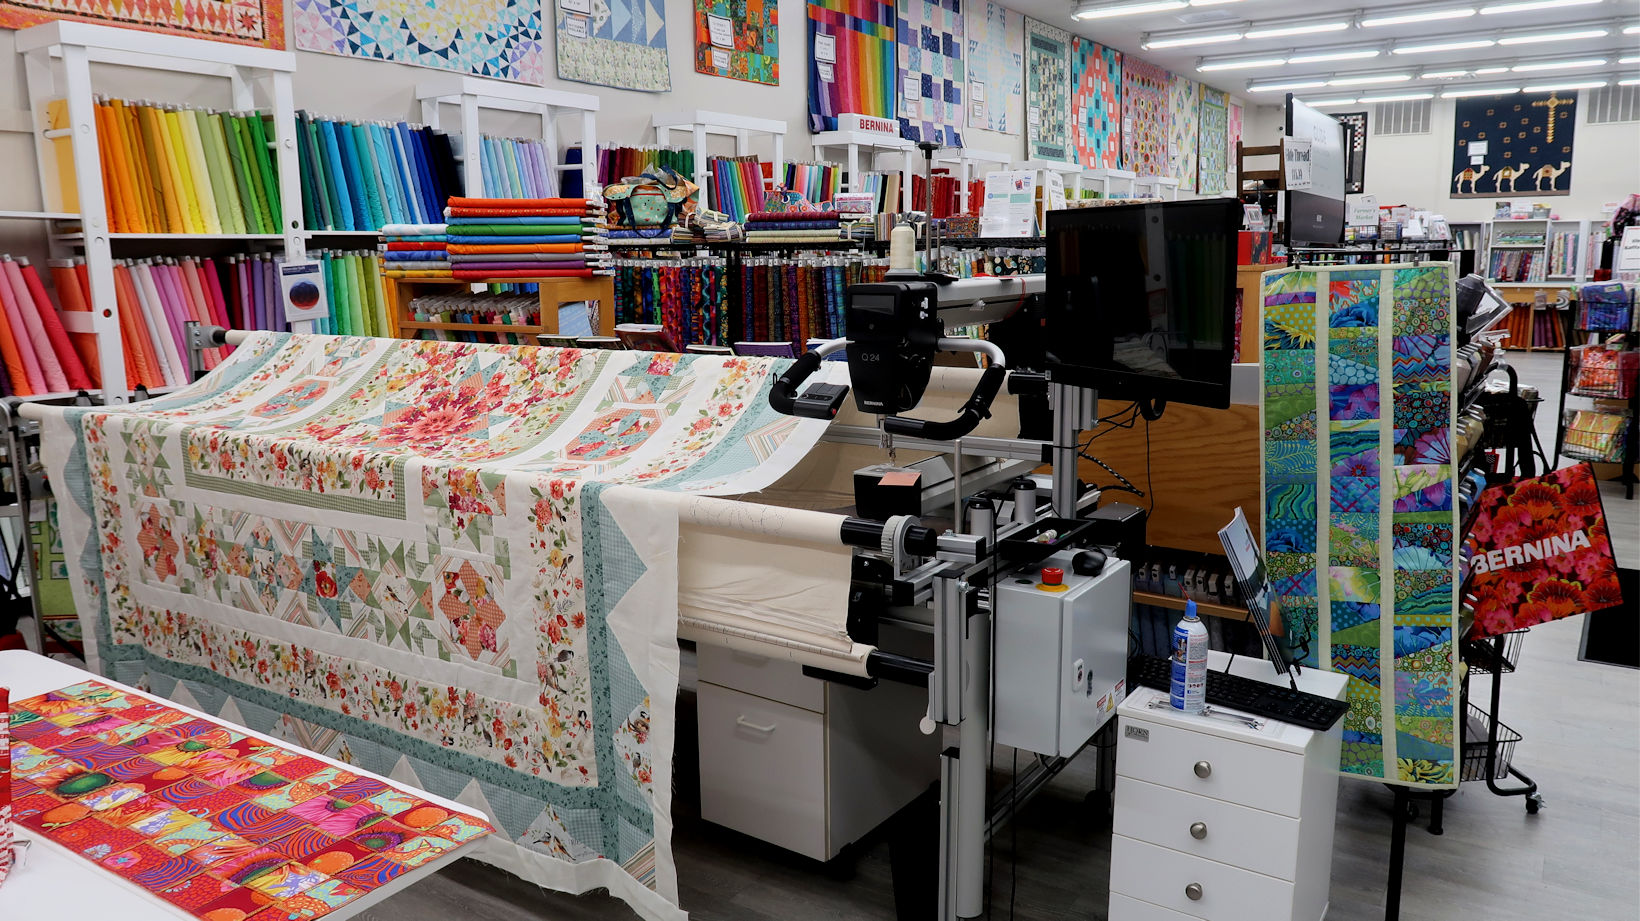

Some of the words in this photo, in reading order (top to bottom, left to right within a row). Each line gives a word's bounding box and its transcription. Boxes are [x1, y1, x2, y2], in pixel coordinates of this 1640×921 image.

[859, 118, 894, 134] BERNINA
[861, 353, 869, 361] Q
[870, 354, 880, 362] 24
[1470, 529, 1592, 575] BERNINA
